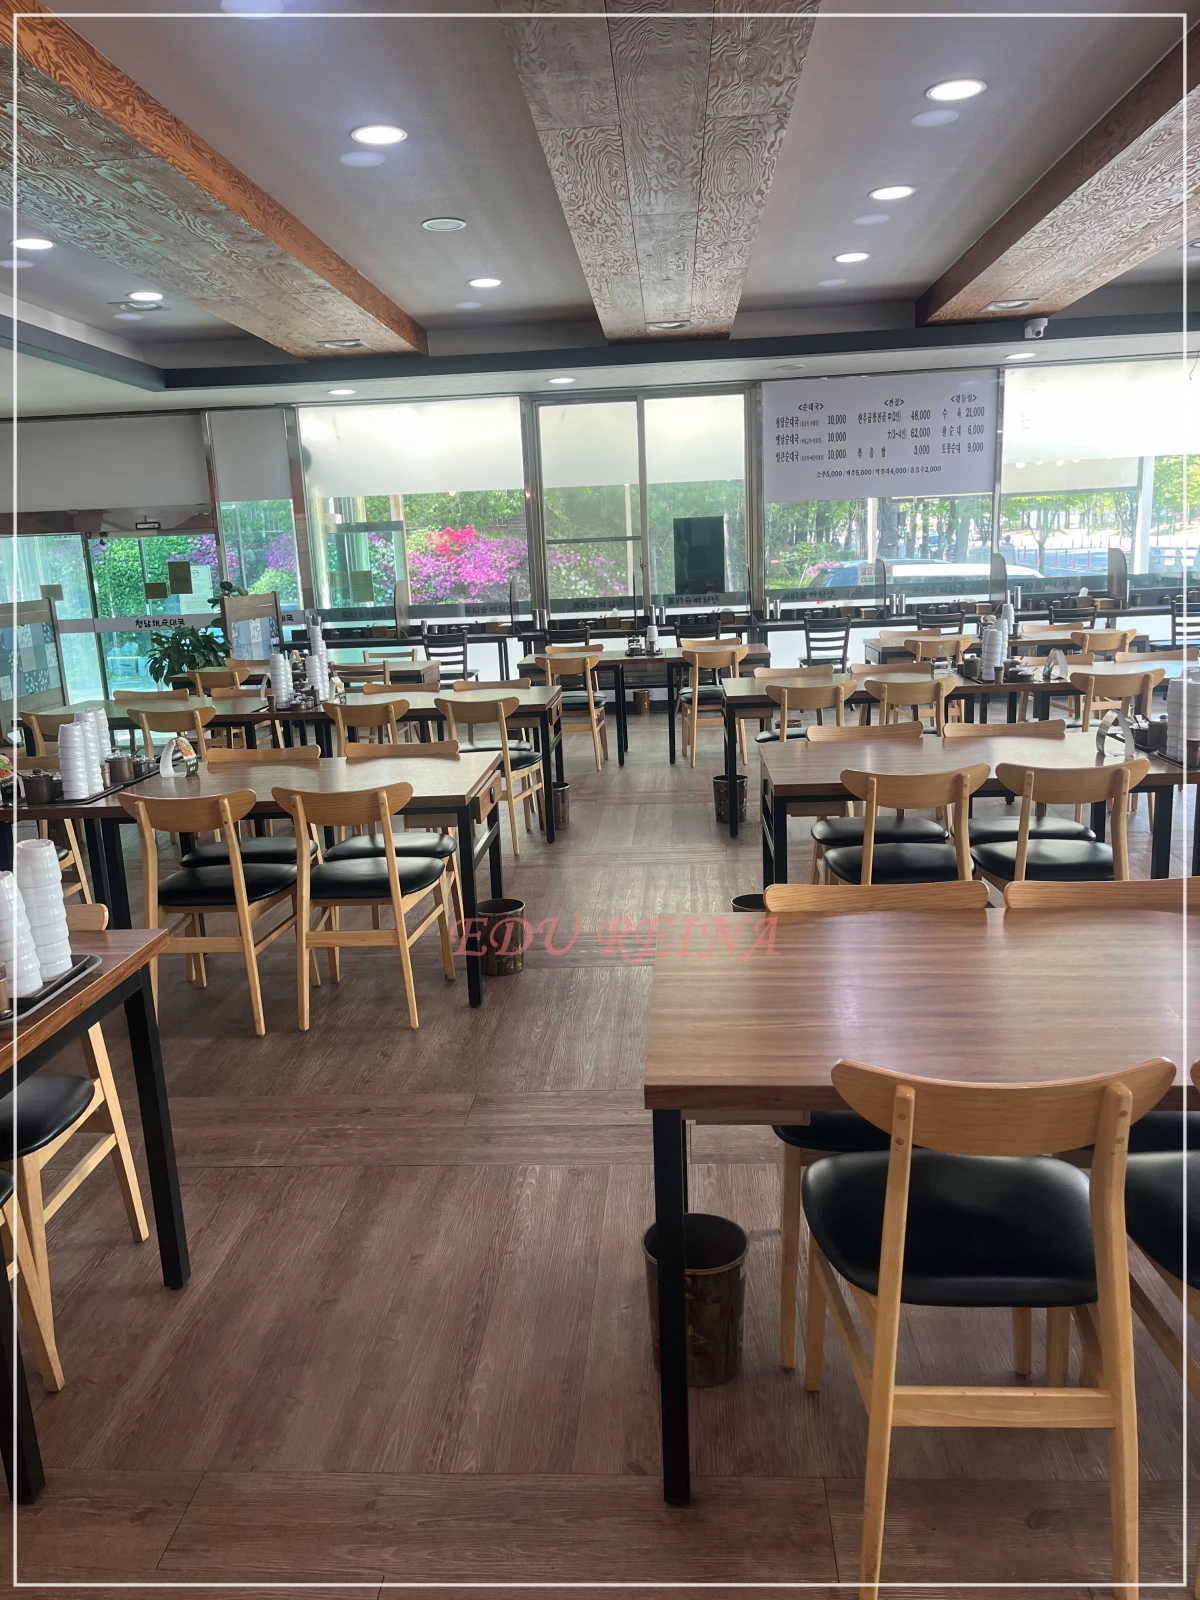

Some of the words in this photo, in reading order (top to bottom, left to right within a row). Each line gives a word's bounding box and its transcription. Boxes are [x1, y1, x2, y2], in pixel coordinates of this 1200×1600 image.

[911, 409, 931, 421] 48,000
[965, 406, 985, 418] 21,000
[827, 414, 847, 425] 10,000
[910, 427, 931, 438] 62,000
[967, 424, 985, 436] 6,000
[827, 431, 847, 443] 10,000
[913, 444, 930, 456] 3,000
[967, 441, 984, 453] 9,000
[827, 448, 847, 460] 10,000
